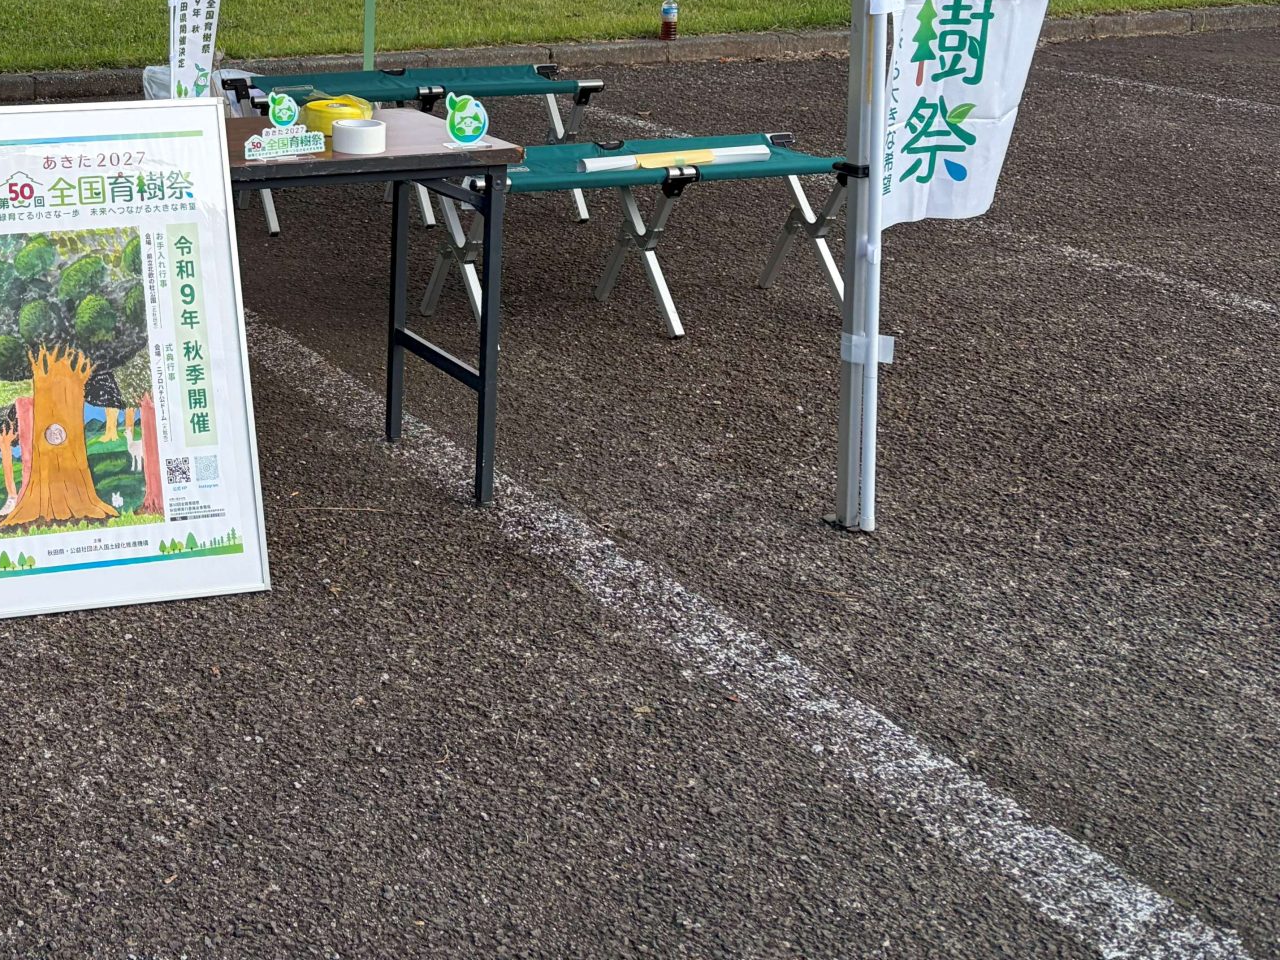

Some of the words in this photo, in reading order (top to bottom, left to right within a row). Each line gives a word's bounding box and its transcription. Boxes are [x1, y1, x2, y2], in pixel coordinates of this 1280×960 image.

[42, 151, 146, 170] あきた2027
[47, 169, 195, 208] 全国育樹祭
[90, 202, 197, 217] 未来へつながる大きな希望
[173, 235, 201, 330] 令和9年
[183, 339, 211, 434] 秋季開催
